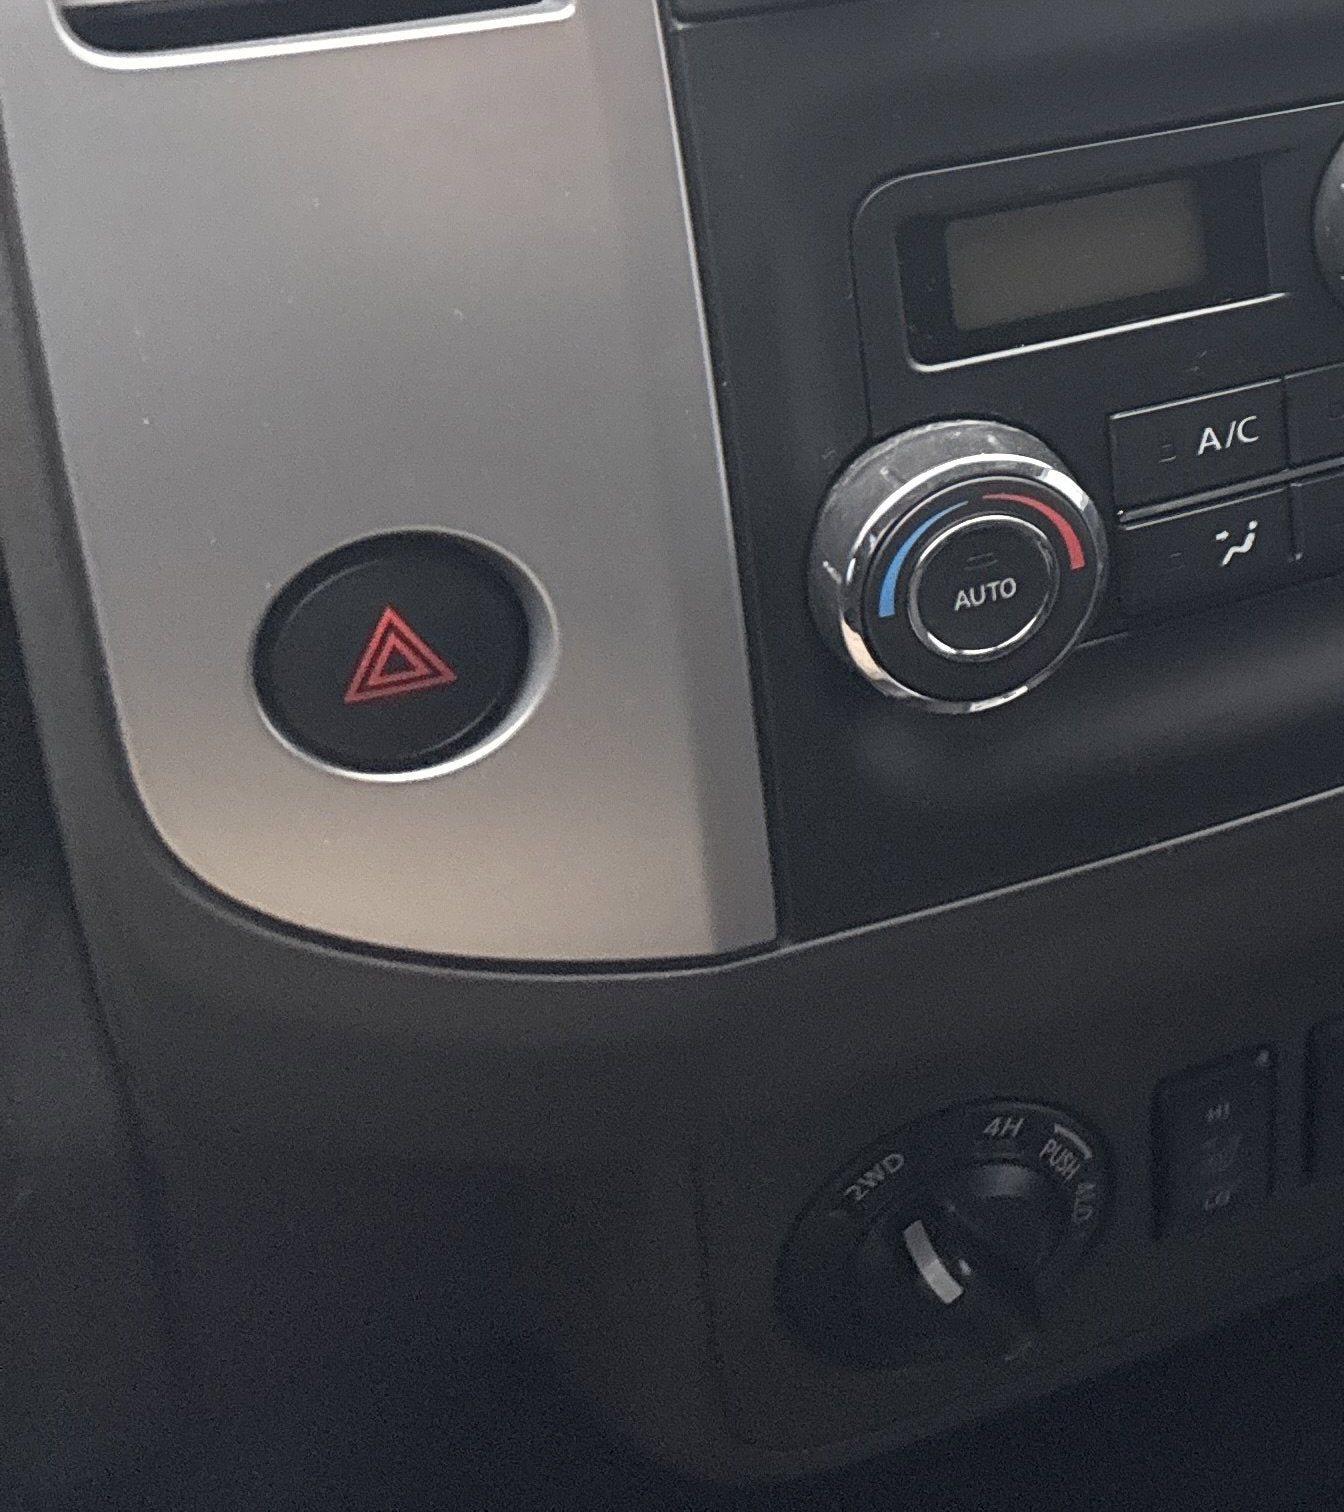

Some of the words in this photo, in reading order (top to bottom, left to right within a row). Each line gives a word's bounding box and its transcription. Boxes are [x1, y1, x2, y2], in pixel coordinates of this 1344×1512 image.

[1197, 415, 1260, 456] A/C
[953, 576, 1018, 613] AUTO
[983, 1116, 1025, 1138] 4H
[845, 1152, 905, 1202] 2WD
[1039, 1138, 1081, 1182] PUSH
